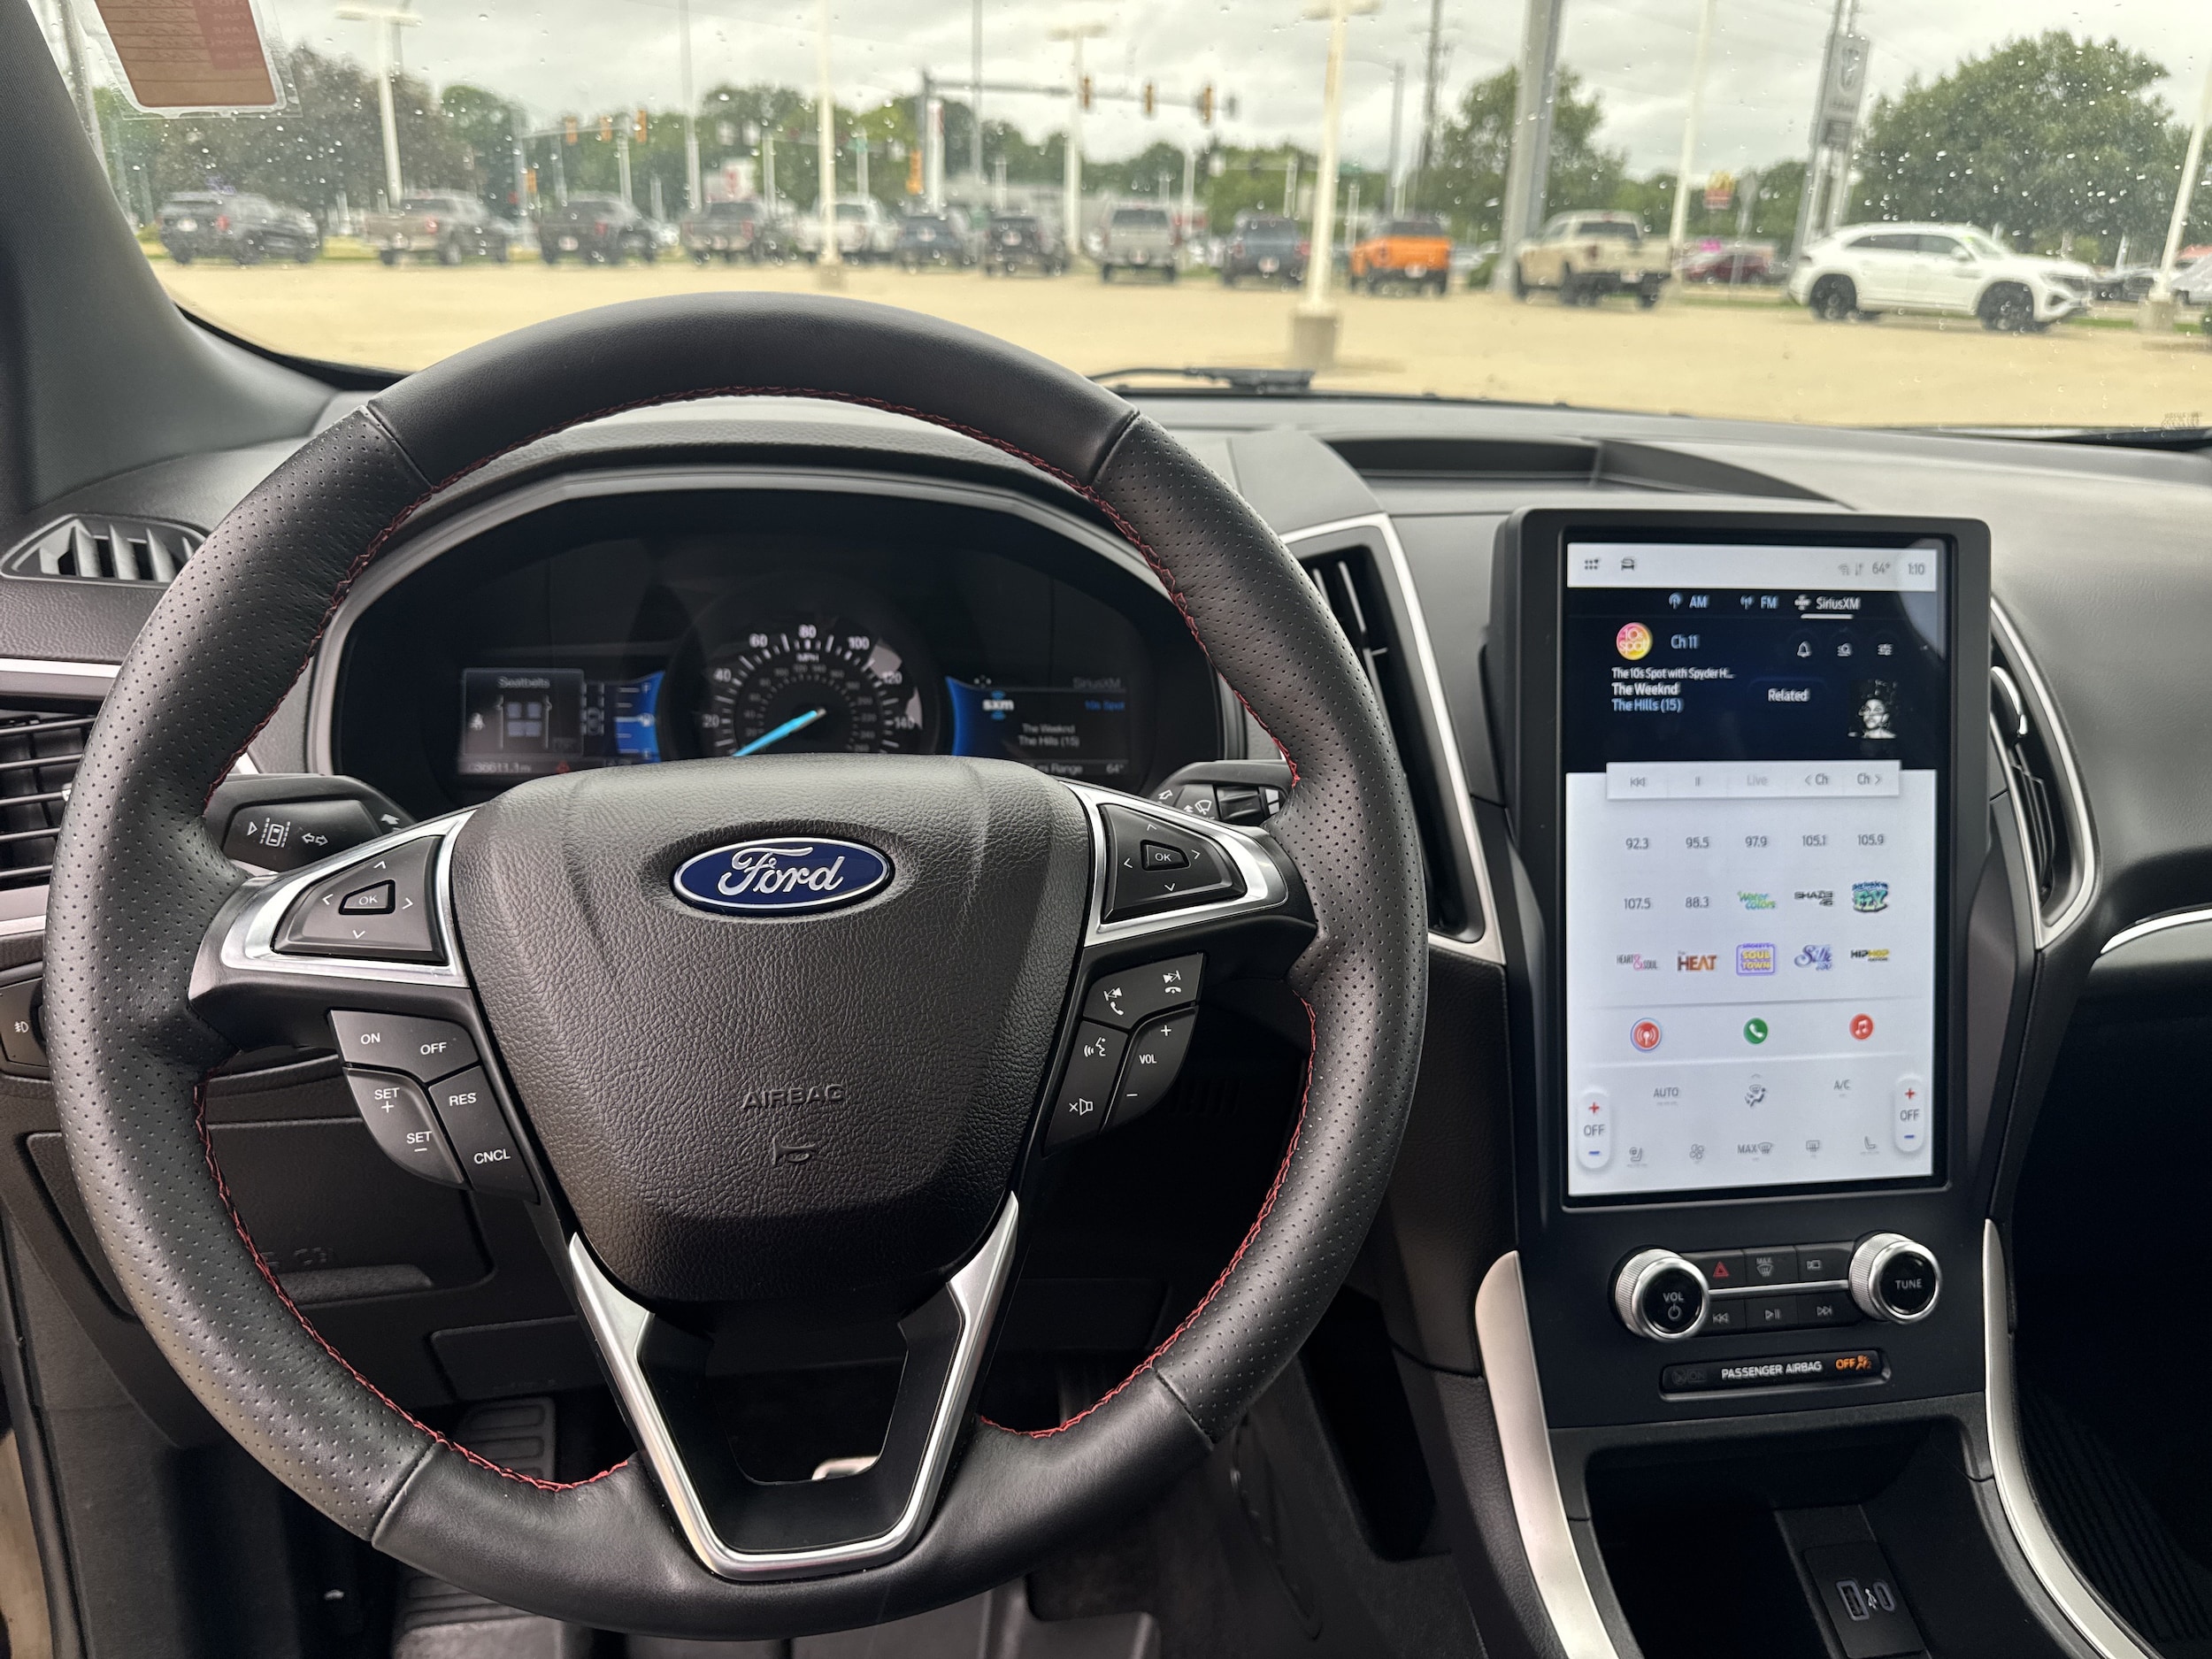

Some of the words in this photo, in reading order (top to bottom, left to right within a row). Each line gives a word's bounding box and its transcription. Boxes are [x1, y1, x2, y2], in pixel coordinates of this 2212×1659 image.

[1907, 563, 1926, 575] 1:10
[1689, 595, 1709, 609] AM
[1760, 595, 1778, 610] FM
[1816, 596, 1861, 610] SiriusXM
[798, 625, 817, 639] 80
[749, 634, 768, 648] 60
[848, 636, 870, 649] 100
[1671, 634, 1686, 649] Ch
[1688, 634, 1700, 649] 11
[796, 653, 819, 663] MPH
[714, 668, 732, 682] 40
[1611, 667, 1630, 679] The
[1630, 667, 1645, 679] 10s
[1646, 667, 1668, 680] Spot
[1668, 667, 1687, 679] with
[1688, 667, 1719, 680] Spyder
[497, 677, 550, 689] Seatbelts
[1611, 682, 1633, 695] The
[1634, 682, 1681, 695] Weeknd
[1768, 687, 1810, 703] Related
[982, 699, 1014, 710] sxm
[1611, 698, 1633, 711] The
[1634, 698, 1660, 711] Hills
[1661, 698, 1684, 713] (15)
[703, 714, 719, 728] 20
[1022, 723, 1039, 733] The
[1018, 735, 1037, 746] The
[1039, 735, 1059, 746] Hills
[1061, 735, 1079, 748] (15)
[1050, 764, 1083, 775] Range
[1747, 774, 1768, 787] Live
[1815, 773, 1829, 786] Ch
[1857, 772, 1871, 786] Ch
[1625, 837, 1650, 849] 92.3
[1686, 836, 1710, 849] 95.5
[1745, 835, 1768, 848] 97.9
[1801, 834, 1827, 846] 105.1
[1857, 833, 1886, 846] 105.9
[1155, 852, 1172, 862] OK
[718, 847, 845, 896] Ford
[358, 895, 378, 906] OK
[1624, 897, 1652, 910] 107.5
[1685, 896, 1709, 909] 88.3
[1741, 950, 1771, 960] SOUL
[1677, 955, 1717, 972] HEAT
[1740, 961, 1771, 971] TOWN
[360, 1033, 380, 1045] ON
[420, 1042, 447, 1055] OFF
[1140, 1054, 1156, 1064] VOL
[1833, 1079, 1851, 1091] A/C
[374, 1087, 399, 1100] SET
[741, 1084, 845, 1109] AIRBAG
[1653, 1087, 1679, 1098] AUTO
[449, 1093, 477, 1106] RES
[1900, 1110, 1920, 1122] OFF
[1583, 1124, 1605, 1136] OFF
[406, 1131, 432, 1144] SET
[1737, 1144, 1756, 1154] MAX
[473, 1148, 511, 1164] CNCL
[1895, 1279, 1923, 1290] TUNE
[1663, 1292, 1684, 1303] VOL
[1721, 1363, 1783, 1380] PASSENGER
[1785, 1361, 1823, 1375] AIRBAG
[1835, 1358, 1855, 1371] OFF
